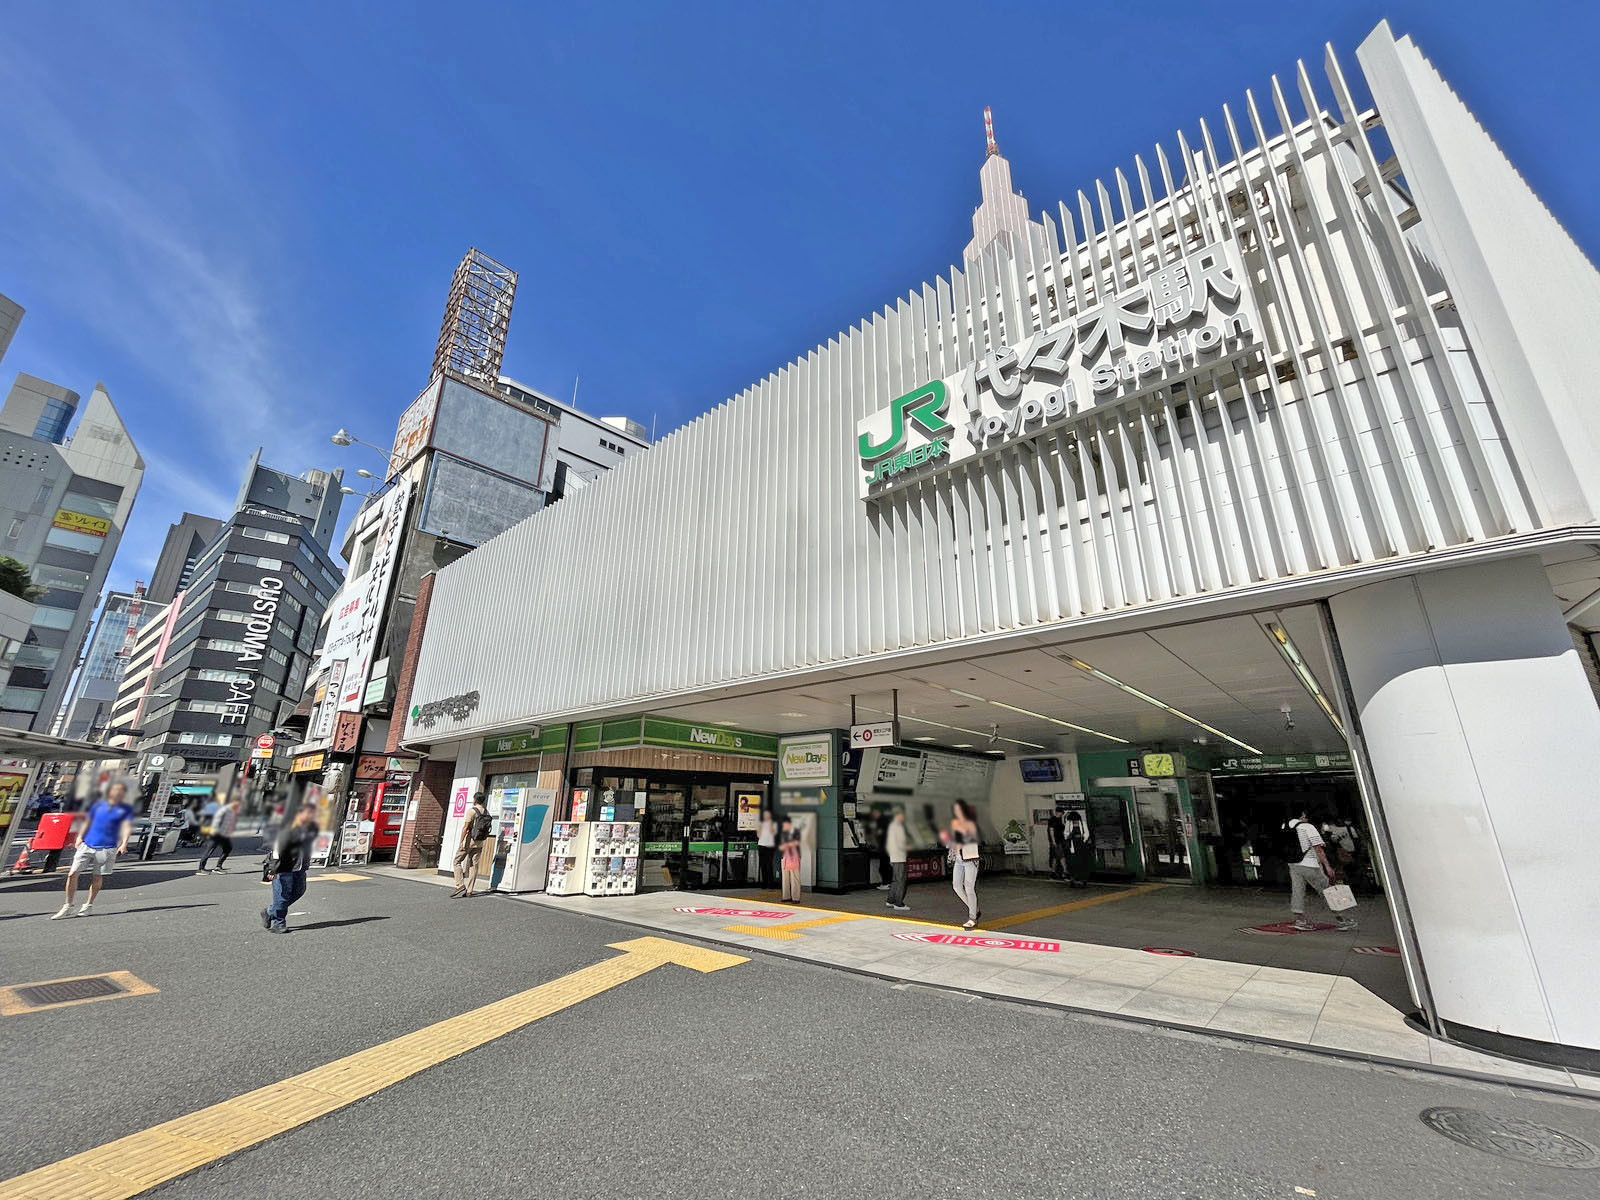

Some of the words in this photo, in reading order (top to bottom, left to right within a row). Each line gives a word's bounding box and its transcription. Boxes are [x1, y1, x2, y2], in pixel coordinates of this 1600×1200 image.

[961, 242, 1240, 418] 代々木駅
[964, 379, 1077, 443] Yoyogi
[1091, 311, 1252, 393] Station
[858, 379, 949, 460] JR
[865, 437, 948, 484] JR東日本
[237, 577, 283, 662] CUSTOMA
[219, 678, 256, 725] CAFE
[690, 728, 742, 748] NewDays
[786, 752, 828, 765] NewDays
